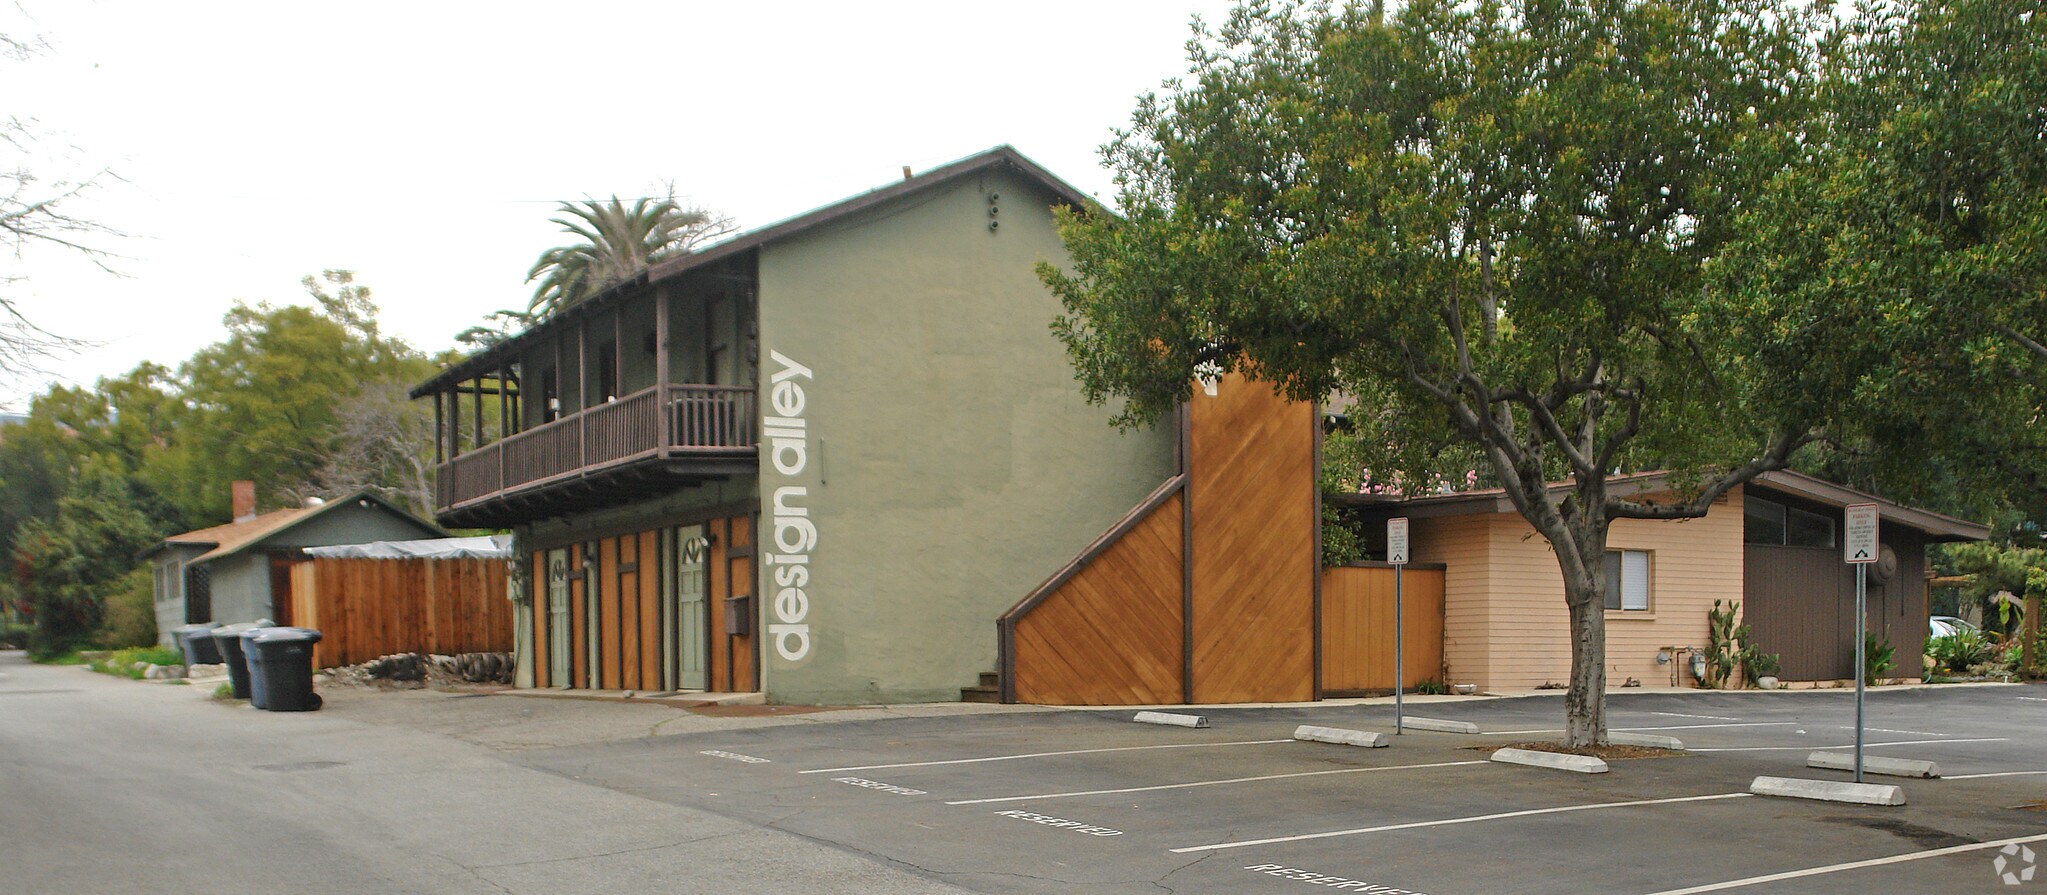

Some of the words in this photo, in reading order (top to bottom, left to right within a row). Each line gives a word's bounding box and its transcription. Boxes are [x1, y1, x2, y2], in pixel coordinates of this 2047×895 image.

[763, 348, 813, 475] alley
[764, 486, 817, 661] design
[993, 809, 1123, 837] RESERVED
[1243, 863, 1428, 895] RESERVE
